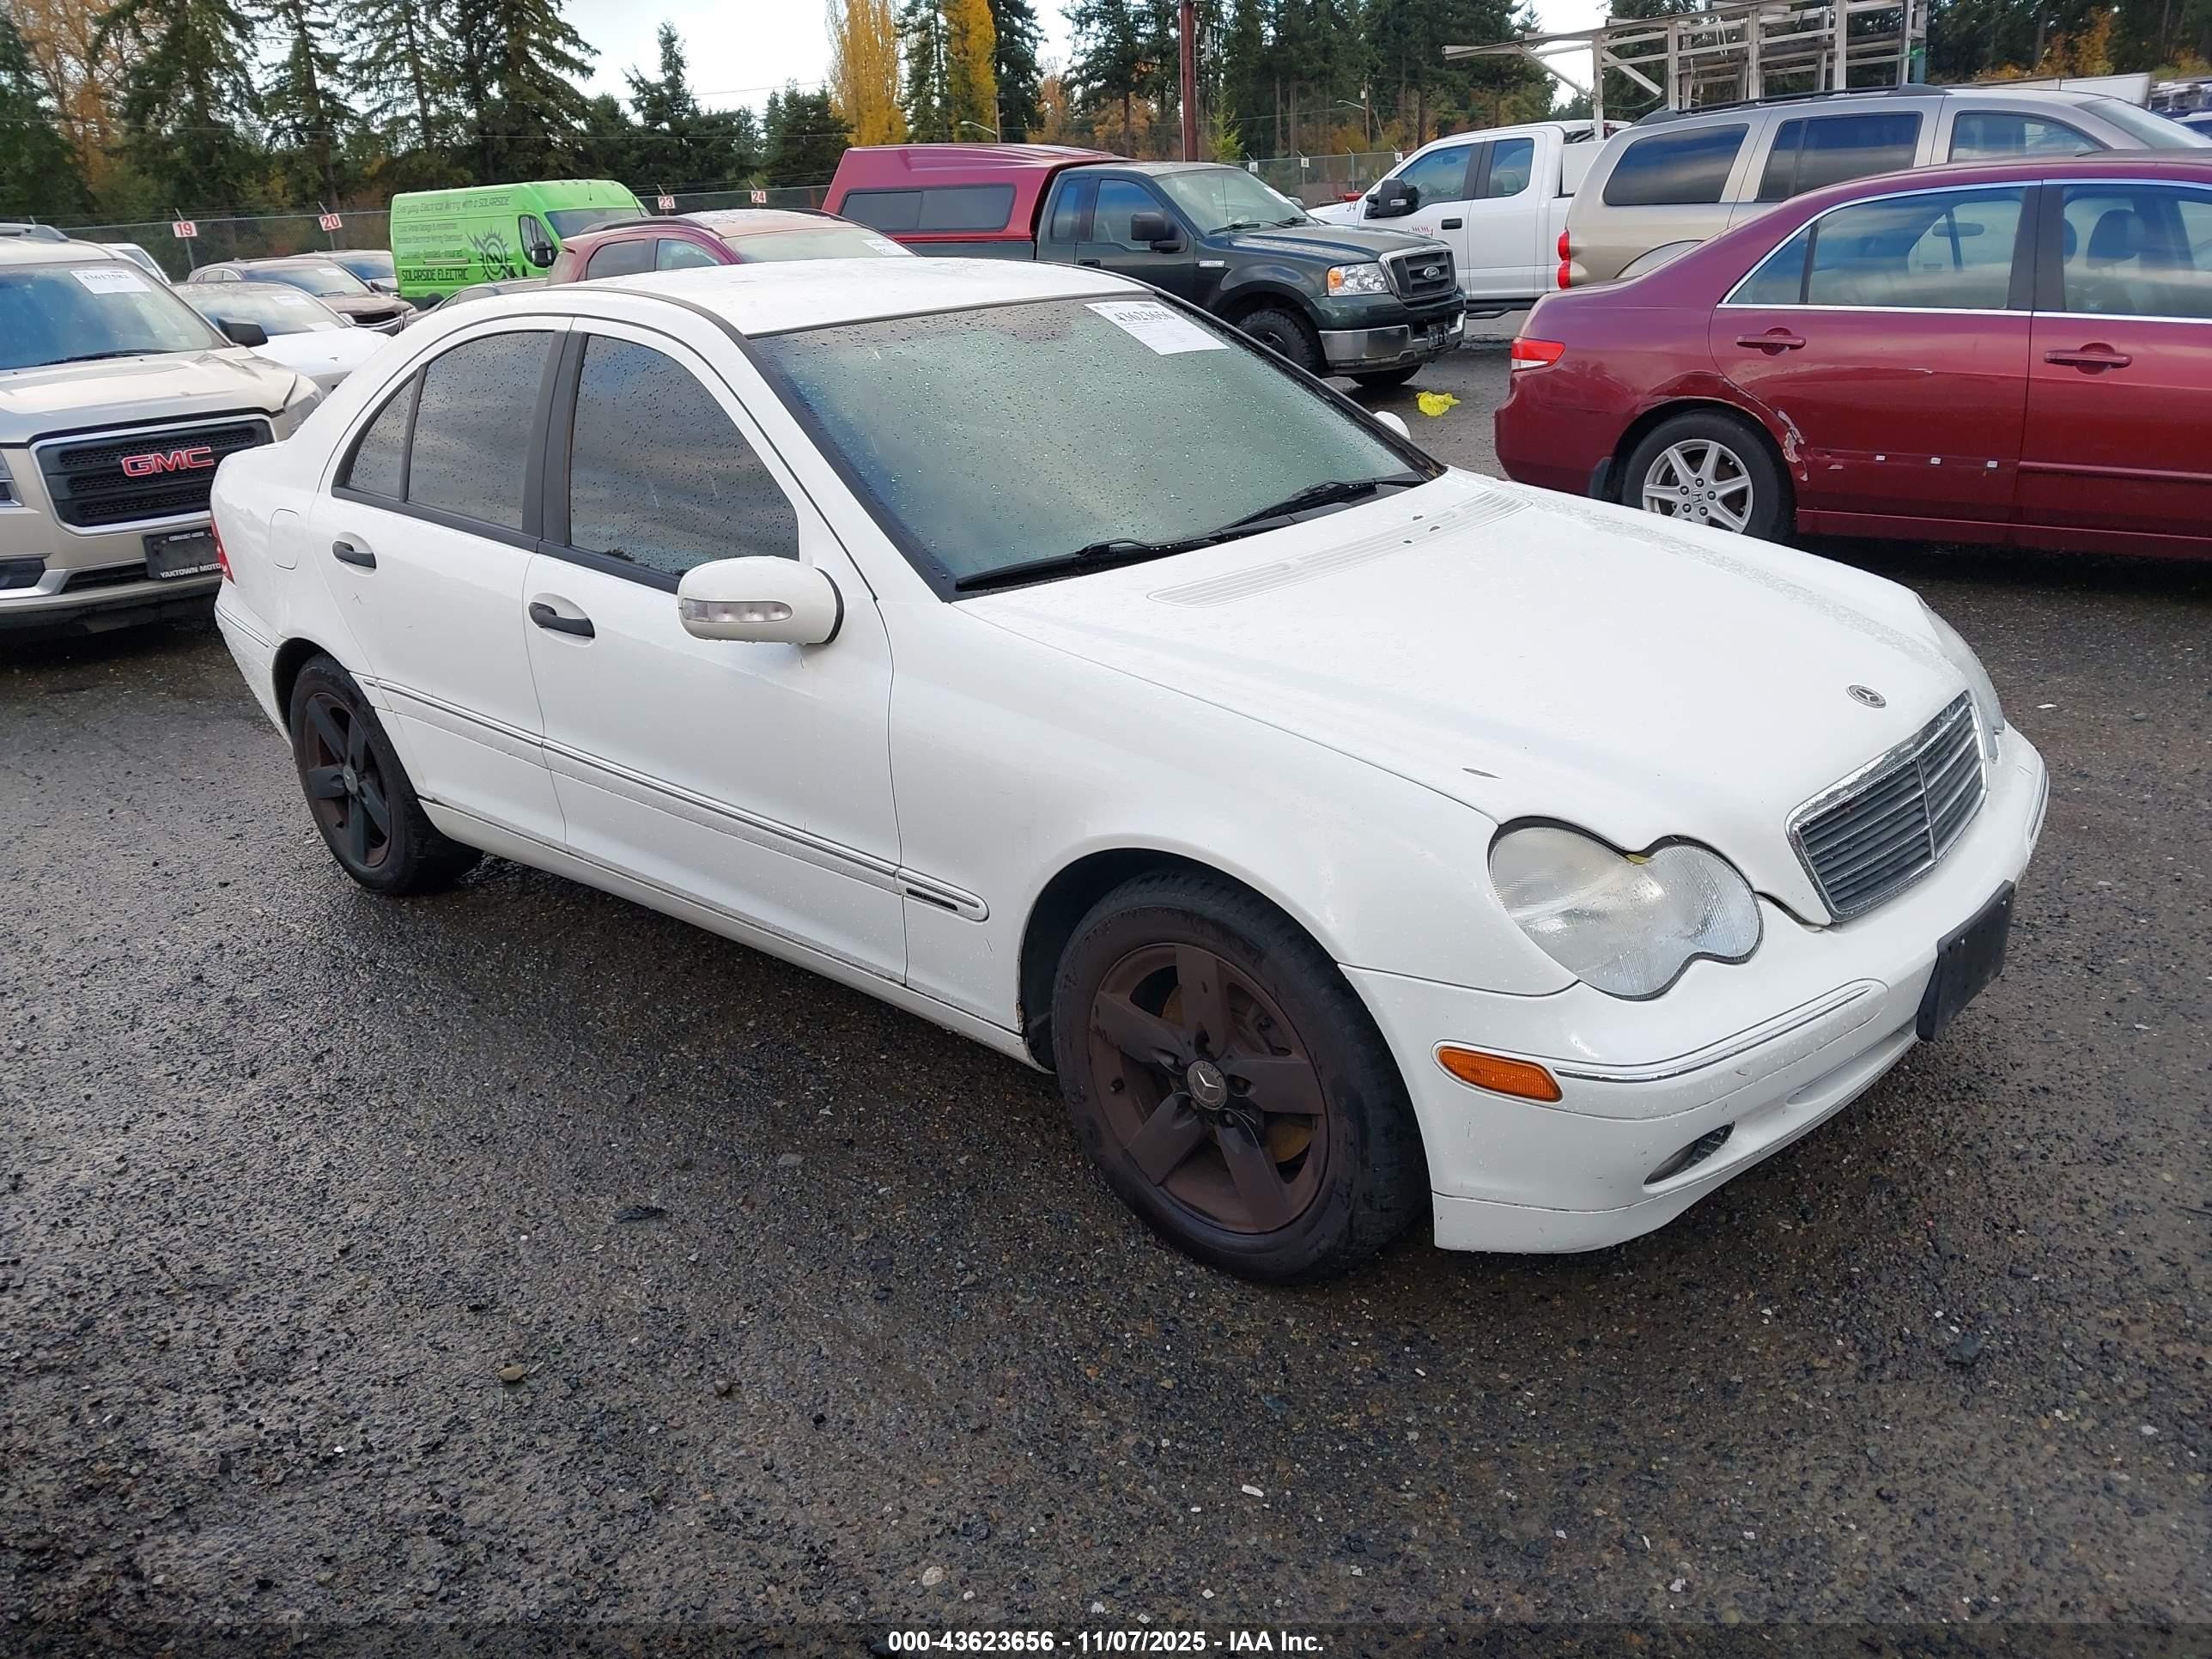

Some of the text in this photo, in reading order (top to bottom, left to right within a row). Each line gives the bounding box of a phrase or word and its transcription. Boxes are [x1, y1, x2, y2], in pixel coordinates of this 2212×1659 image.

[659, 197, 673, 208] 23
[752, 191, 764, 203] 24
[176, 222, 193, 236] 19
[323, 215, 340, 229] 20
[401, 268, 469, 283] SOLARSIDE ELECTRIC
[1114, 311, 1176, 322] 43623656
[121, 447, 214, 477] GMC
